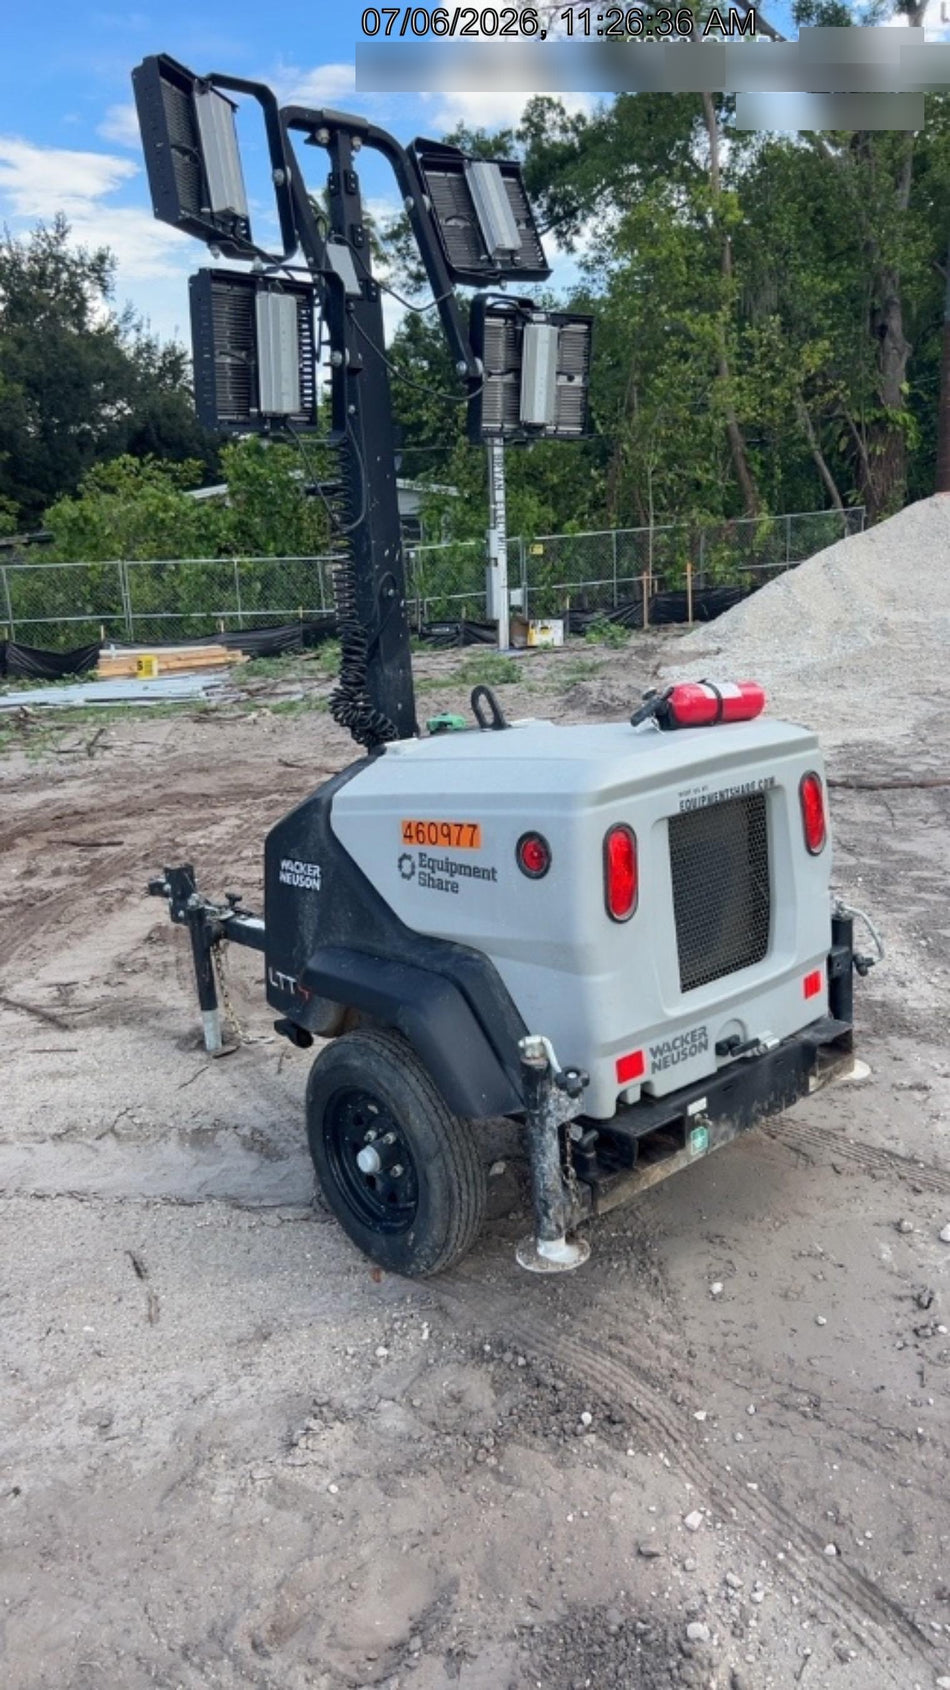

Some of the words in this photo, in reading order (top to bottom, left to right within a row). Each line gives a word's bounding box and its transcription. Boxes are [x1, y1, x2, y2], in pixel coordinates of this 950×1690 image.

[403, 821, 478, 847] 460977
[280, 859, 321, 878] WACKER
[418, 852, 498, 882] Equipment
[279, 871, 321, 892] NEUSON
[418, 871, 460, 894] Share
[649, 1025, 708, 1060] WACKER
[651, 1038, 709, 1074] NEUSON
